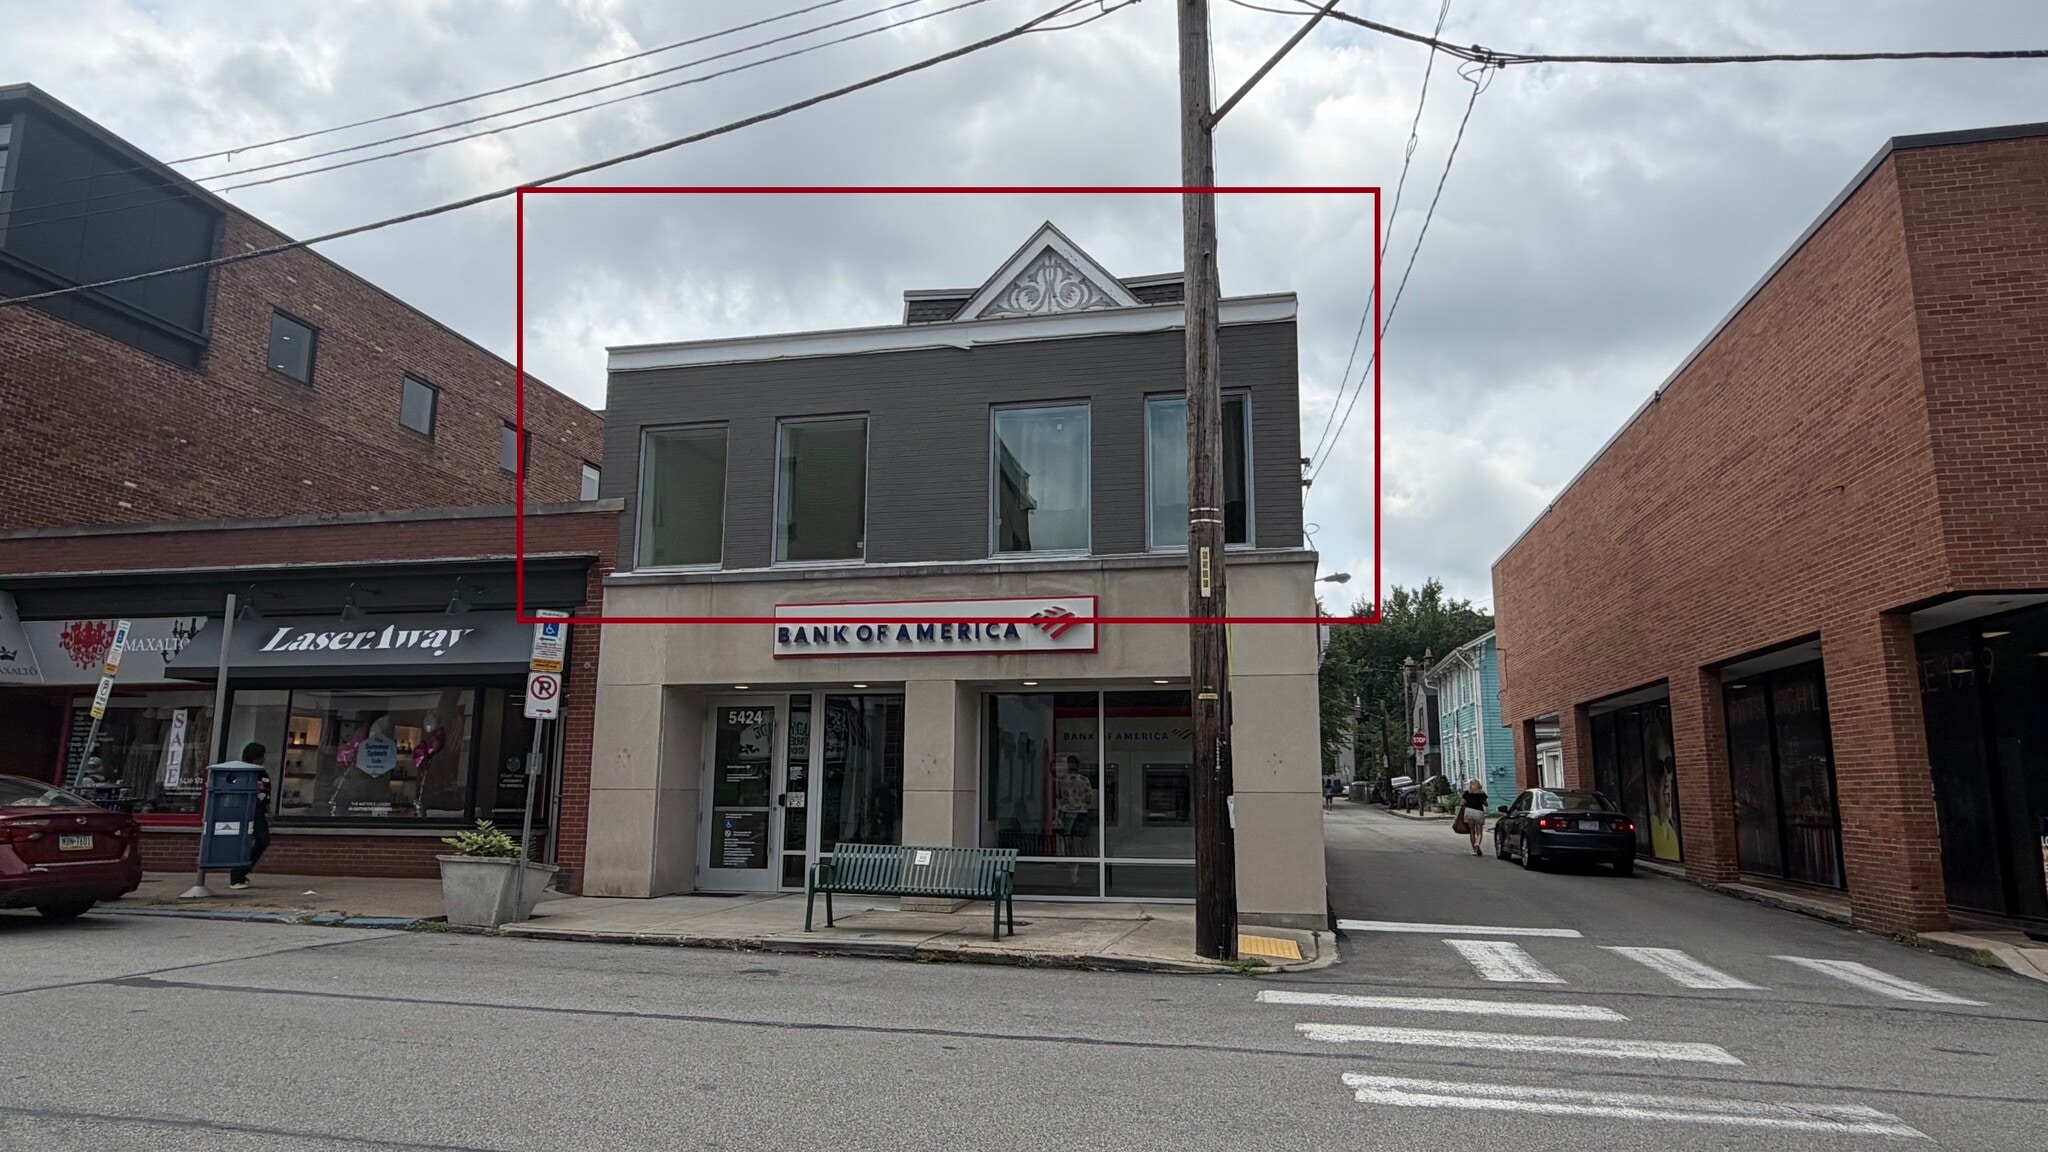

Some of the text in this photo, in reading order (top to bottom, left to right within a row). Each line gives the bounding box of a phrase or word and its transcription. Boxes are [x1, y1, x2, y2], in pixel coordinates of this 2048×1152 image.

[259, 624, 475, 656] LaserAway
[778, 622, 1020, 645] BANK OF AMERICA
[728, 710, 763, 724] 5424
[1064, 732, 1094, 741] BANK
[1115, 732, 1168, 741] AMERICA
[166, 713, 185, 784] SALE
[365, 742, 389, 750] Summer
[367, 750, 387, 758] Splash
